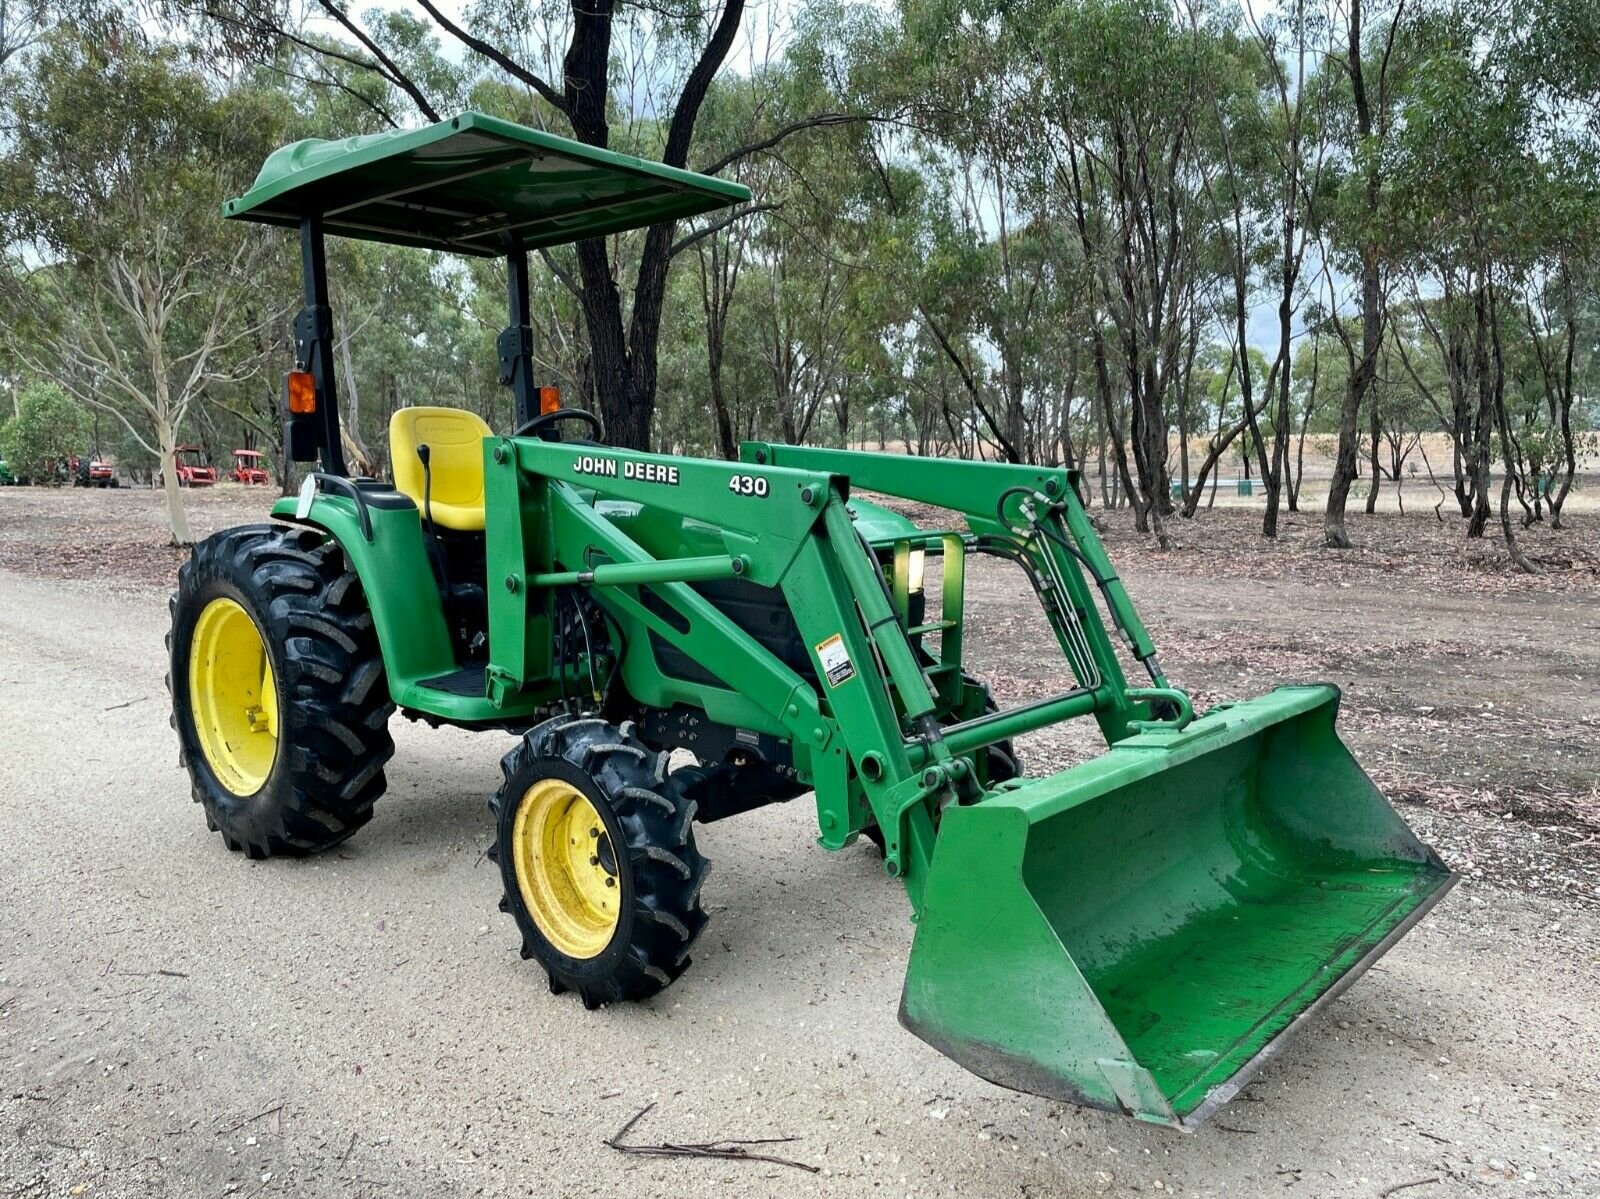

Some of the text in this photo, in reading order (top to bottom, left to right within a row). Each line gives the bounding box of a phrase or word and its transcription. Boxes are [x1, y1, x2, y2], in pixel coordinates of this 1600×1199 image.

[573, 456, 679, 485] JOHN DEERE
[729, 475, 769, 497] 430
